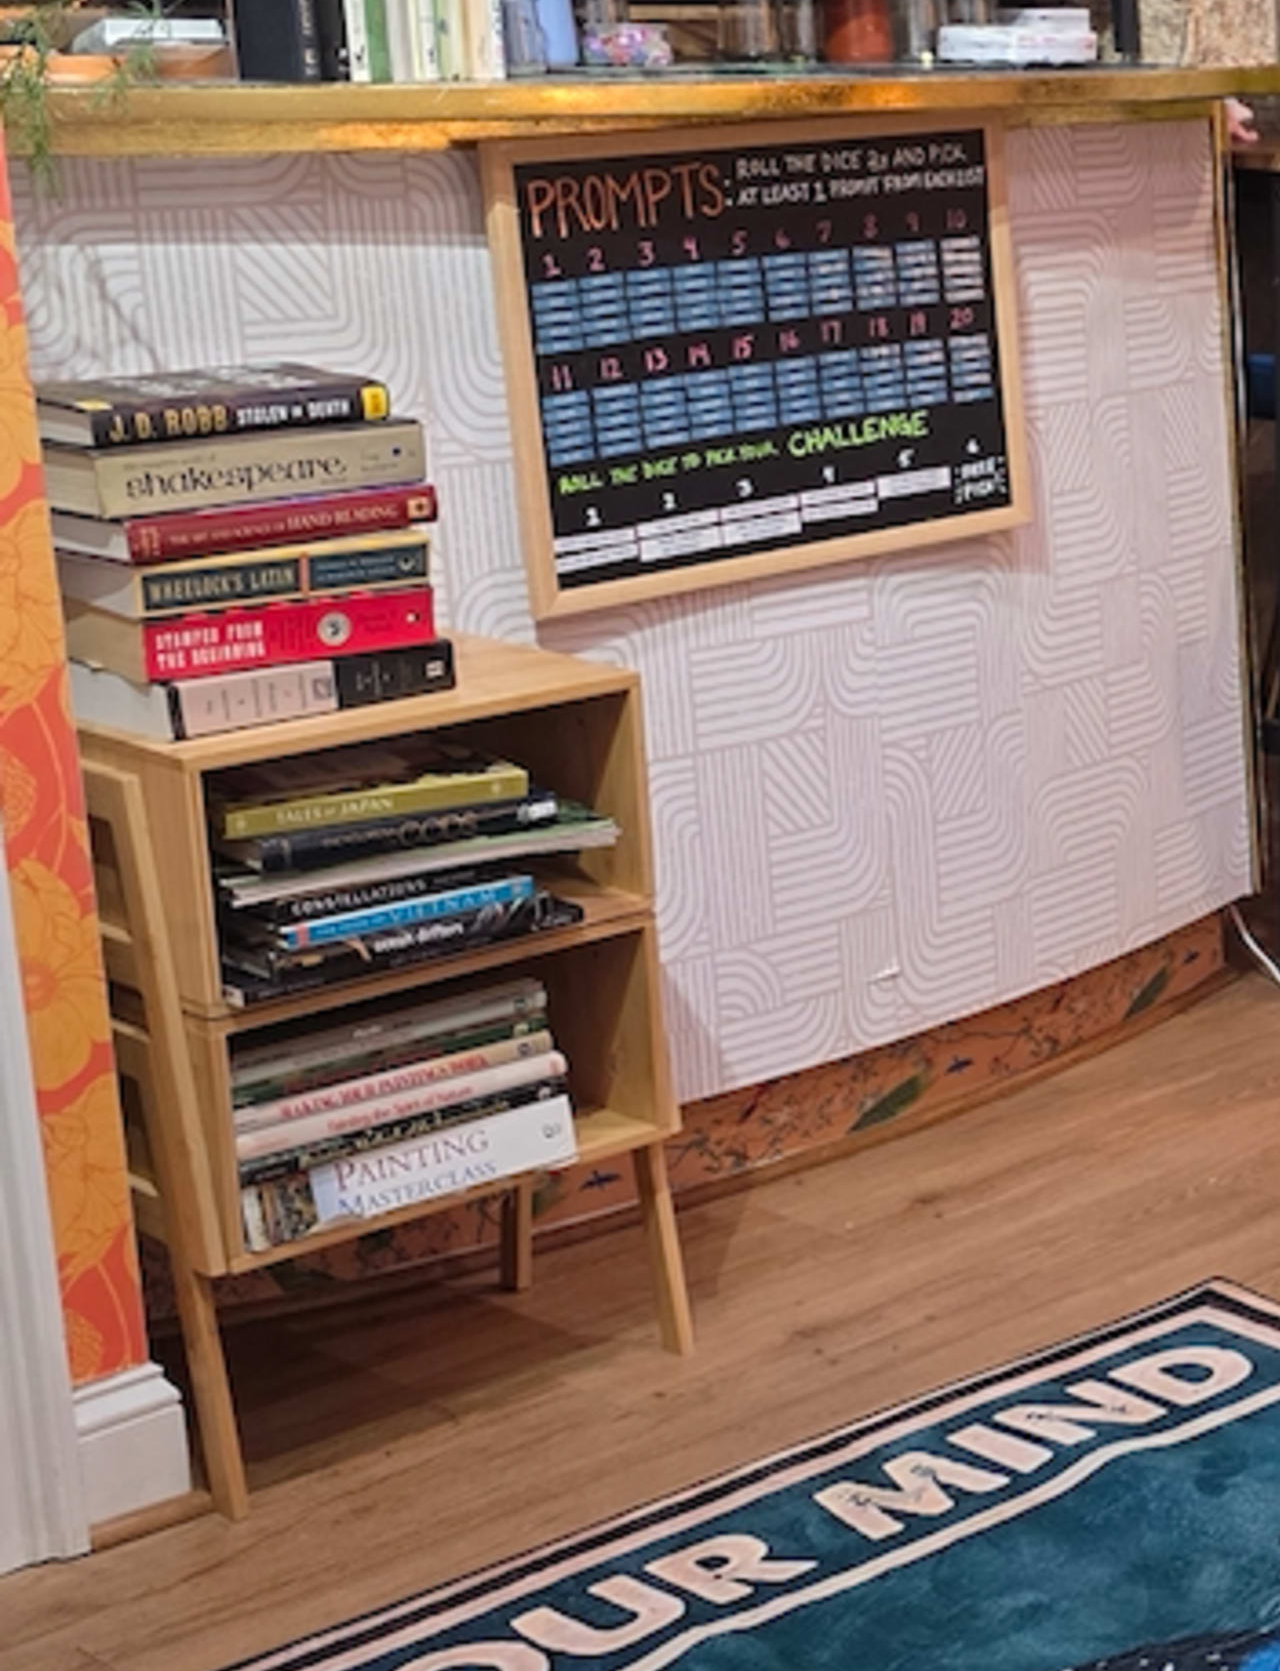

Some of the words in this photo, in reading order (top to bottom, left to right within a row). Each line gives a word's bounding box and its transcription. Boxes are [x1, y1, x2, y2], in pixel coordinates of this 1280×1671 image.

[735, 157, 780, 178] ROLL
[784, 153, 817, 174] THE
[822, 149, 861, 173] DICE
[893, 146, 926, 167] AND
[929, 142, 967, 164] PICK
[737, 186, 757, 206] AT
[761, 184, 810, 205] LEAST
[542, 255, 562, 278] 1
[587, 249, 606, 272] 2
[637, 240, 657, 265] 3
[682, 236, 701, 261] 4
[731, 230, 748, 255] 5
[773, 227, 791, 249] 6
[816, 223, 832, 244] 7
[862, 215, 880, 238] 8
[906, 213, 921, 235] 9
[946, 207, 968, 229] 10
[552, 365, 574, 391] 11
[600, 357, 624, 381] 12
[644, 347, 668, 373] 13
[688, 342, 712, 367] 14
[733, 334, 754, 360] 15
[778, 329, 800, 353] 16
[820, 322, 842, 345] 17
[869, 316, 890, 339] 18
[909, 313, 928, 335] 19
[949, 307, 975, 329] 20
[109, 415, 129, 443] J.
[134, 411, 157, 440] D.
[164, 403, 228, 435] ROBB
[236, 404, 289, 427] STOLEN
[307, 399, 350, 420] DEATH
[558, 472, 603, 495] ROLL
[609, 465, 639, 485] THE
[681, 451, 701, 471] TO
[787, 409, 930, 458] CHALLENGE
[662, 492, 676, 511] 2
[736, 478, 753, 497] 3
[286, 510, 332, 531] HAND
[334, 502, 398, 527] READING
[150, 570, 245, 600] WHEELOCK'S
[251, 565, 295, 591] LATIN
[155, 625, 220, 652] STAMPED
[225, 619, 264, 643] FROM
[156, 650, 187, 671] THE
[191, 640, 266, 667] BEGINNING
[276, 805, 326, 825] TALES
[340, 797, 395, 817] JAPAN
[291, 878, 427, 916] CONSTELLATIONS
[389, 889, 497, 923] VIETNAM
[339, 1085, 375, 1105] YOUR
[333, 1130, 489, 1192] PAINTING
[338, 1161, 497, 1218] MASTERCLASS
[813, 1345, 1256, 1542] MIND
